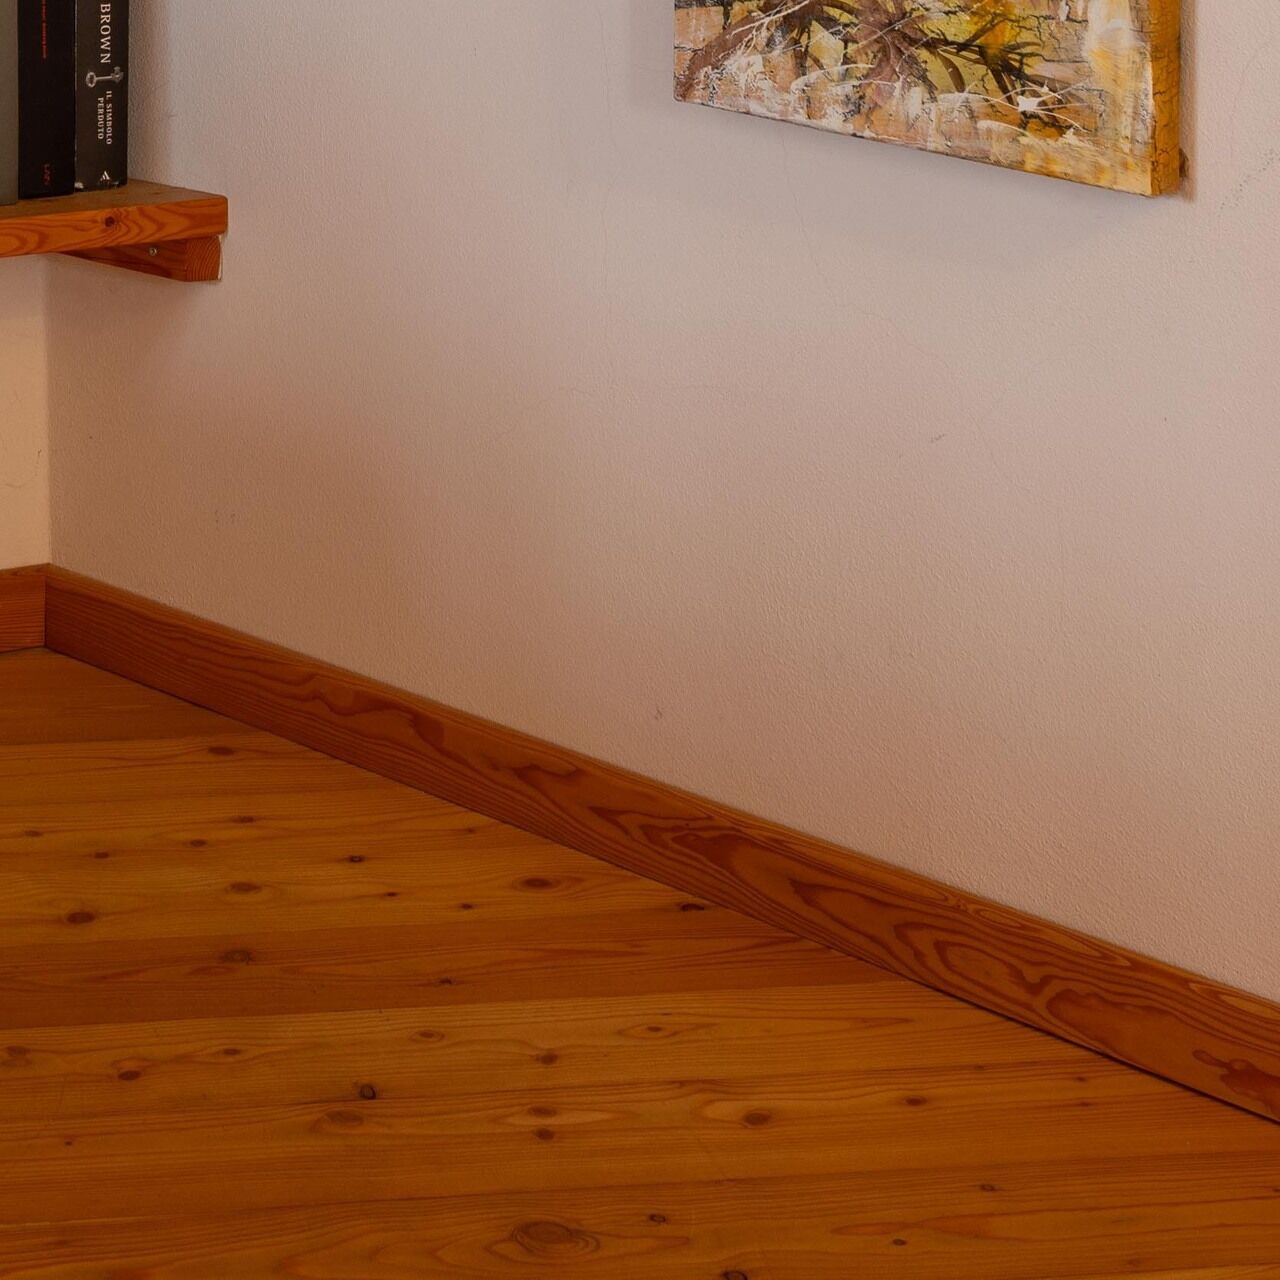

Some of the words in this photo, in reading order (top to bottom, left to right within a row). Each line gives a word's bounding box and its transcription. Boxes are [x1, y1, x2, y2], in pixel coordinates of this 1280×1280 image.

[100, 3, 112, 64] BROWN
[106, 90, 112, 100] IL
[97, 97, 105, 140] PERDUTO
